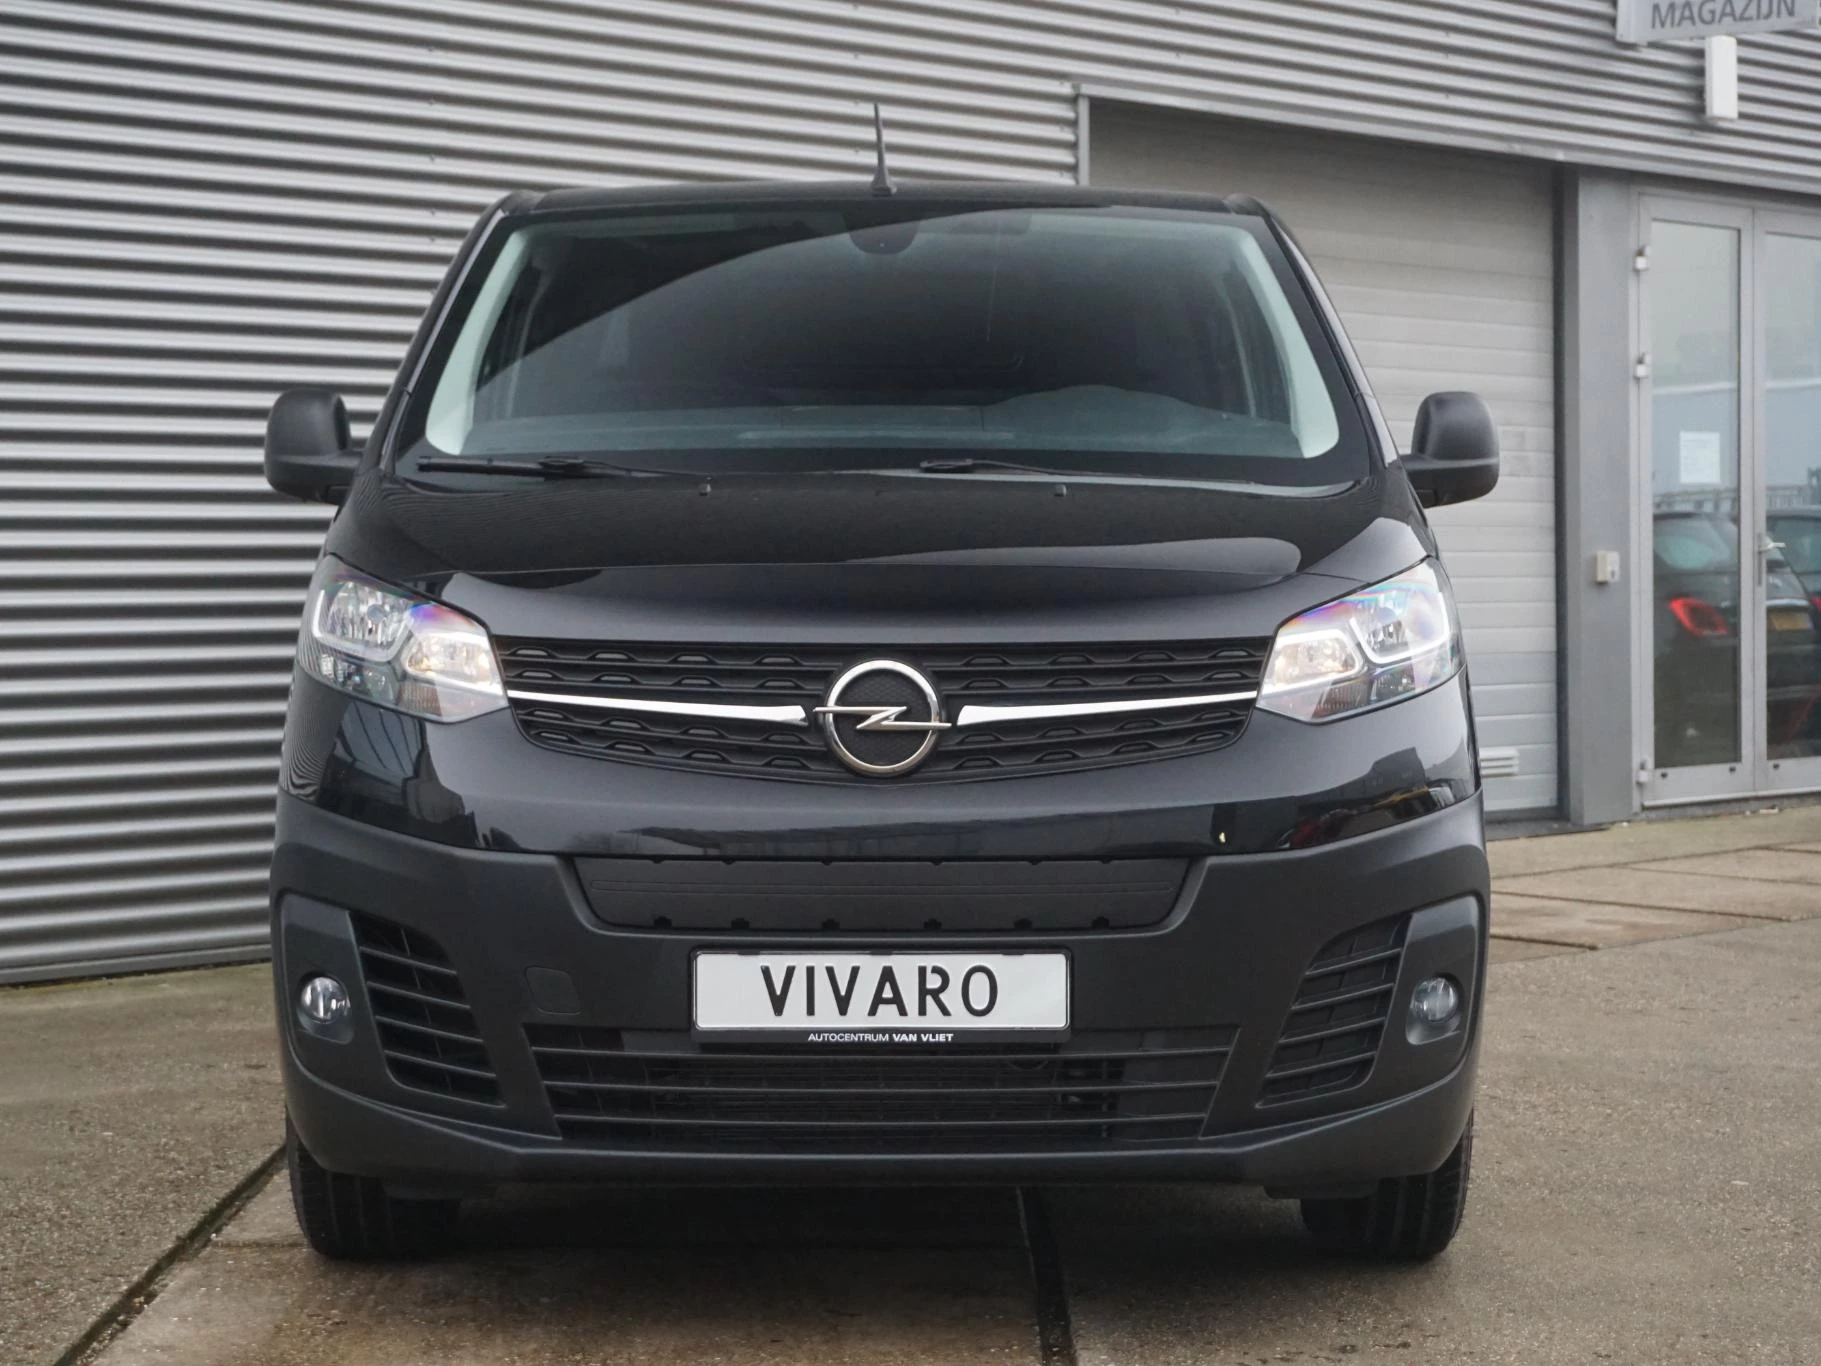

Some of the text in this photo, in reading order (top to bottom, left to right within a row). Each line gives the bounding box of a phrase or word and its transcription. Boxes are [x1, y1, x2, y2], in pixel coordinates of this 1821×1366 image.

[1651, 0, 1796, 29] MAGAZIJN
[760, 965, 998, 1017] VIVARO
[807, 1033, 954, 1042] AUTOCENTRUM VAN VLIET
